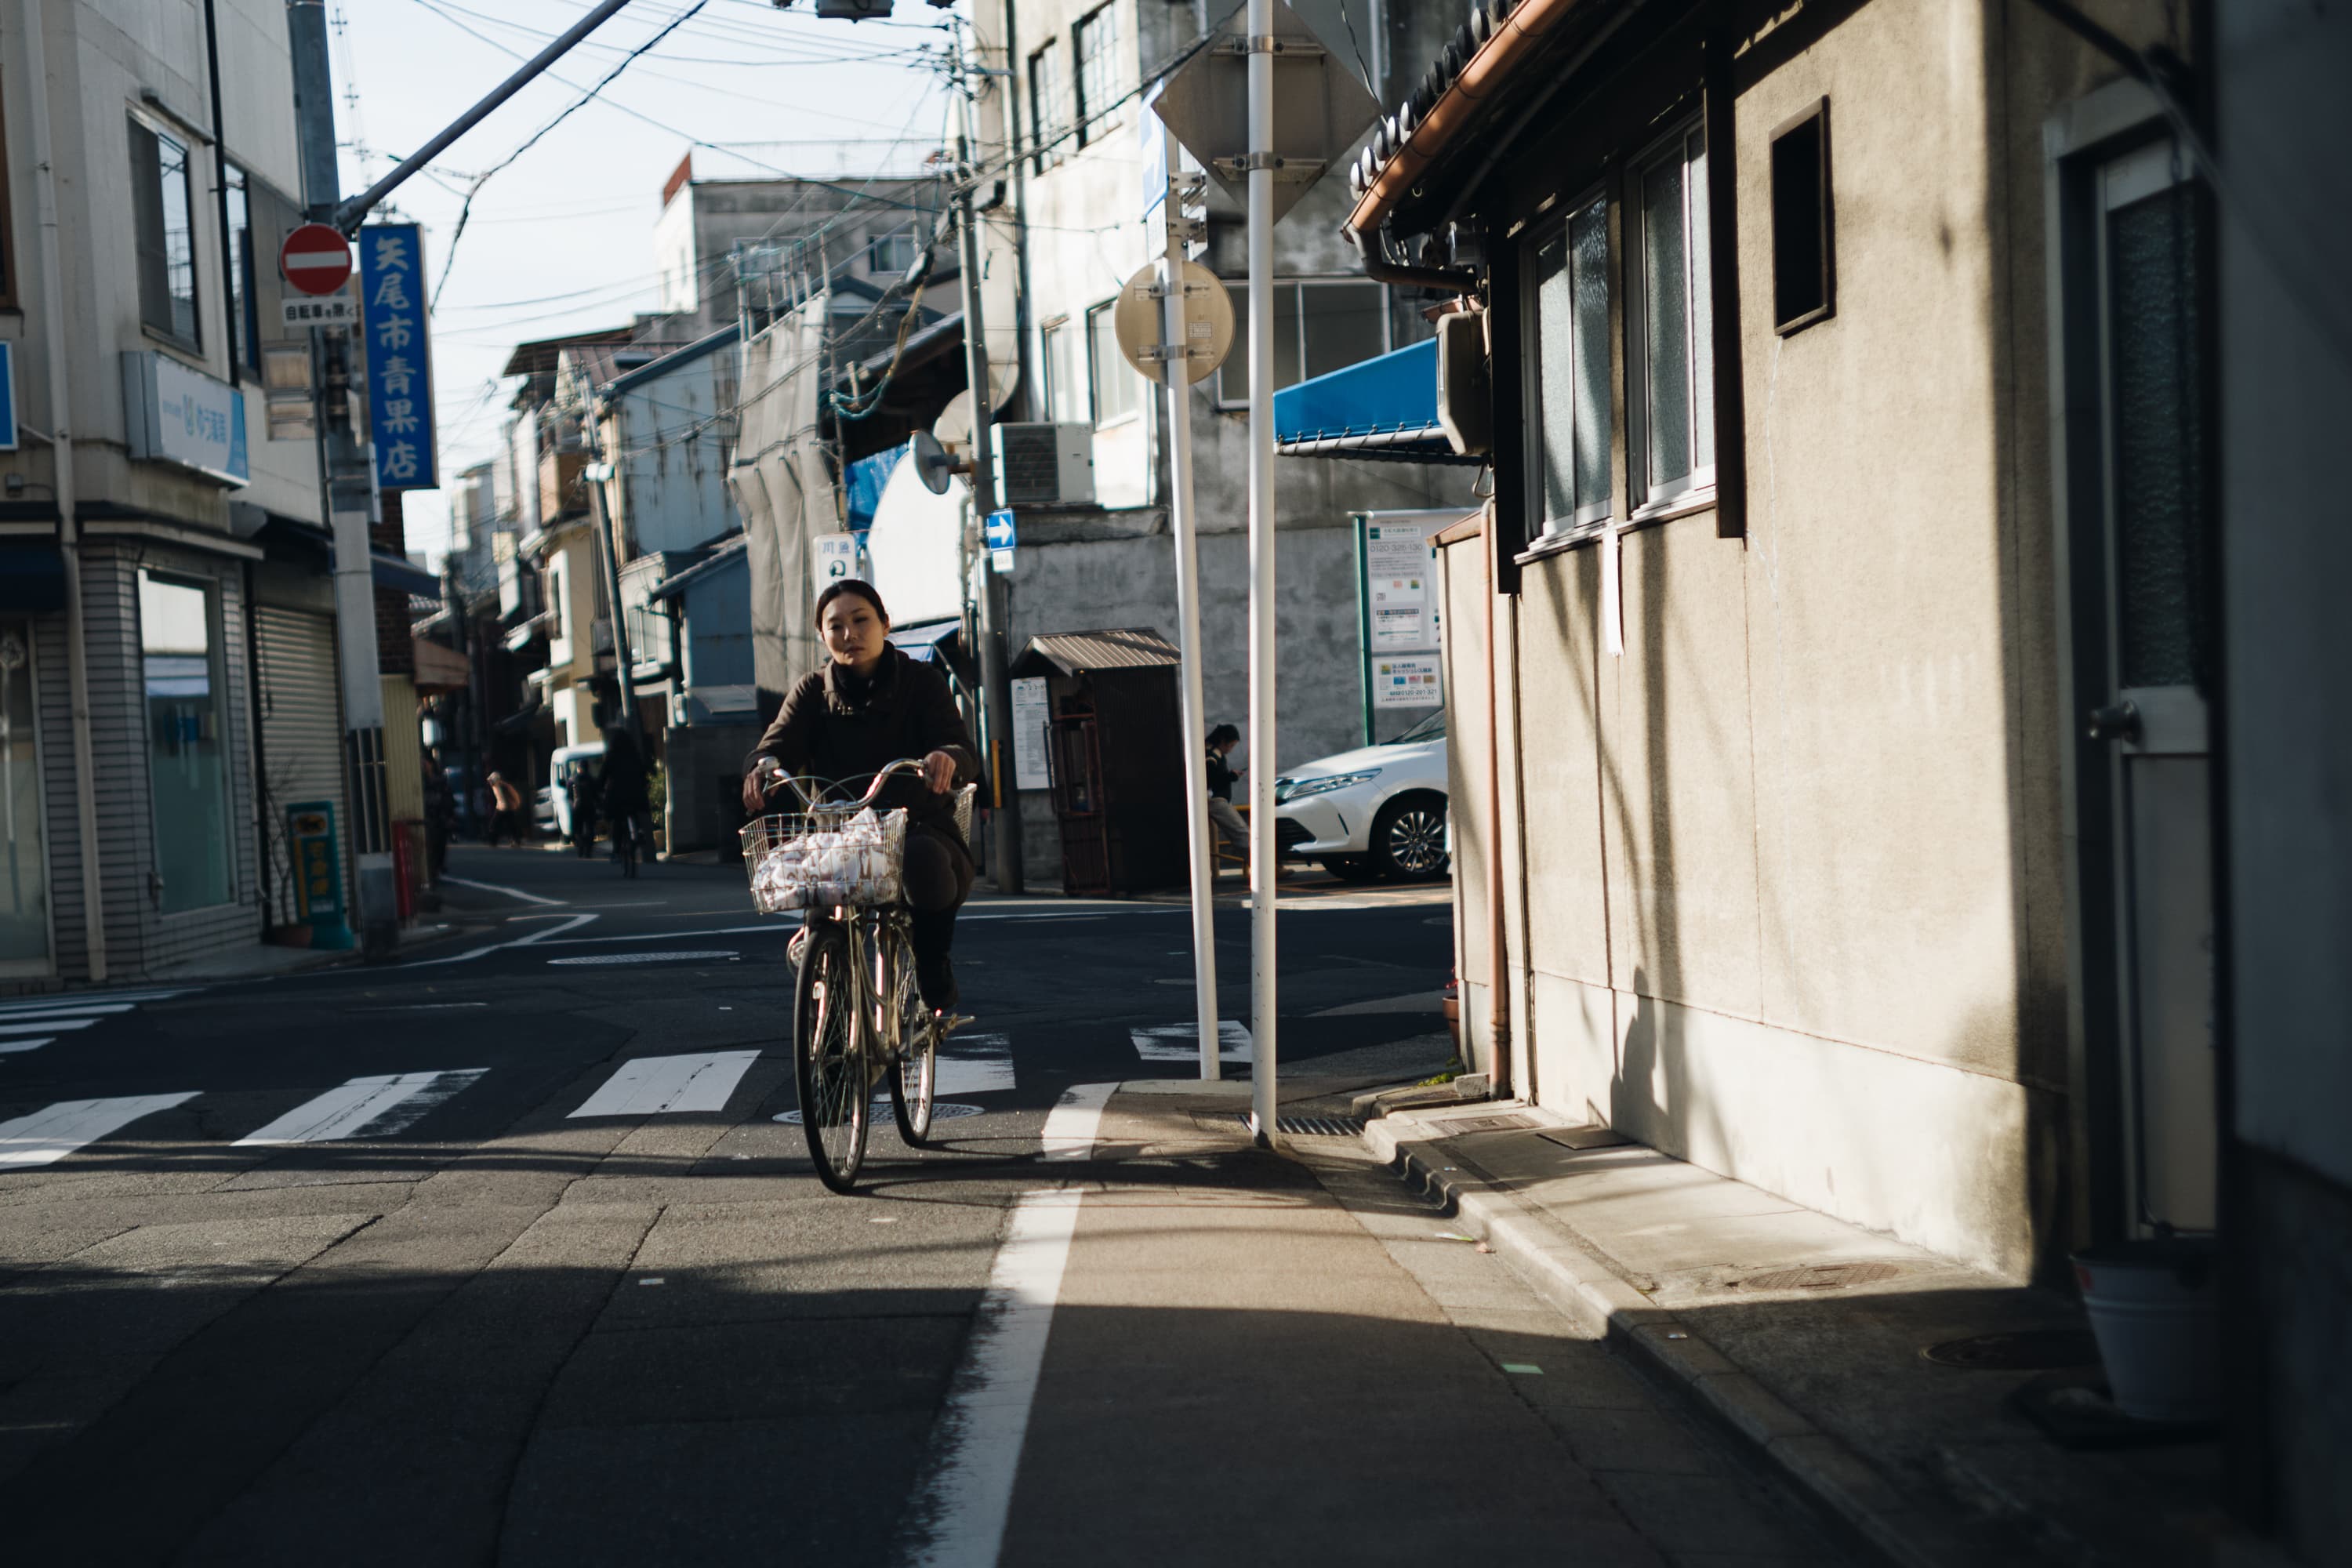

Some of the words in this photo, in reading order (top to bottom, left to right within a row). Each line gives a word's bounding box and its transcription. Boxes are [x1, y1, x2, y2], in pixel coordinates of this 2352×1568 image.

[373, 236, 419, 479] 矢尾市青果店
